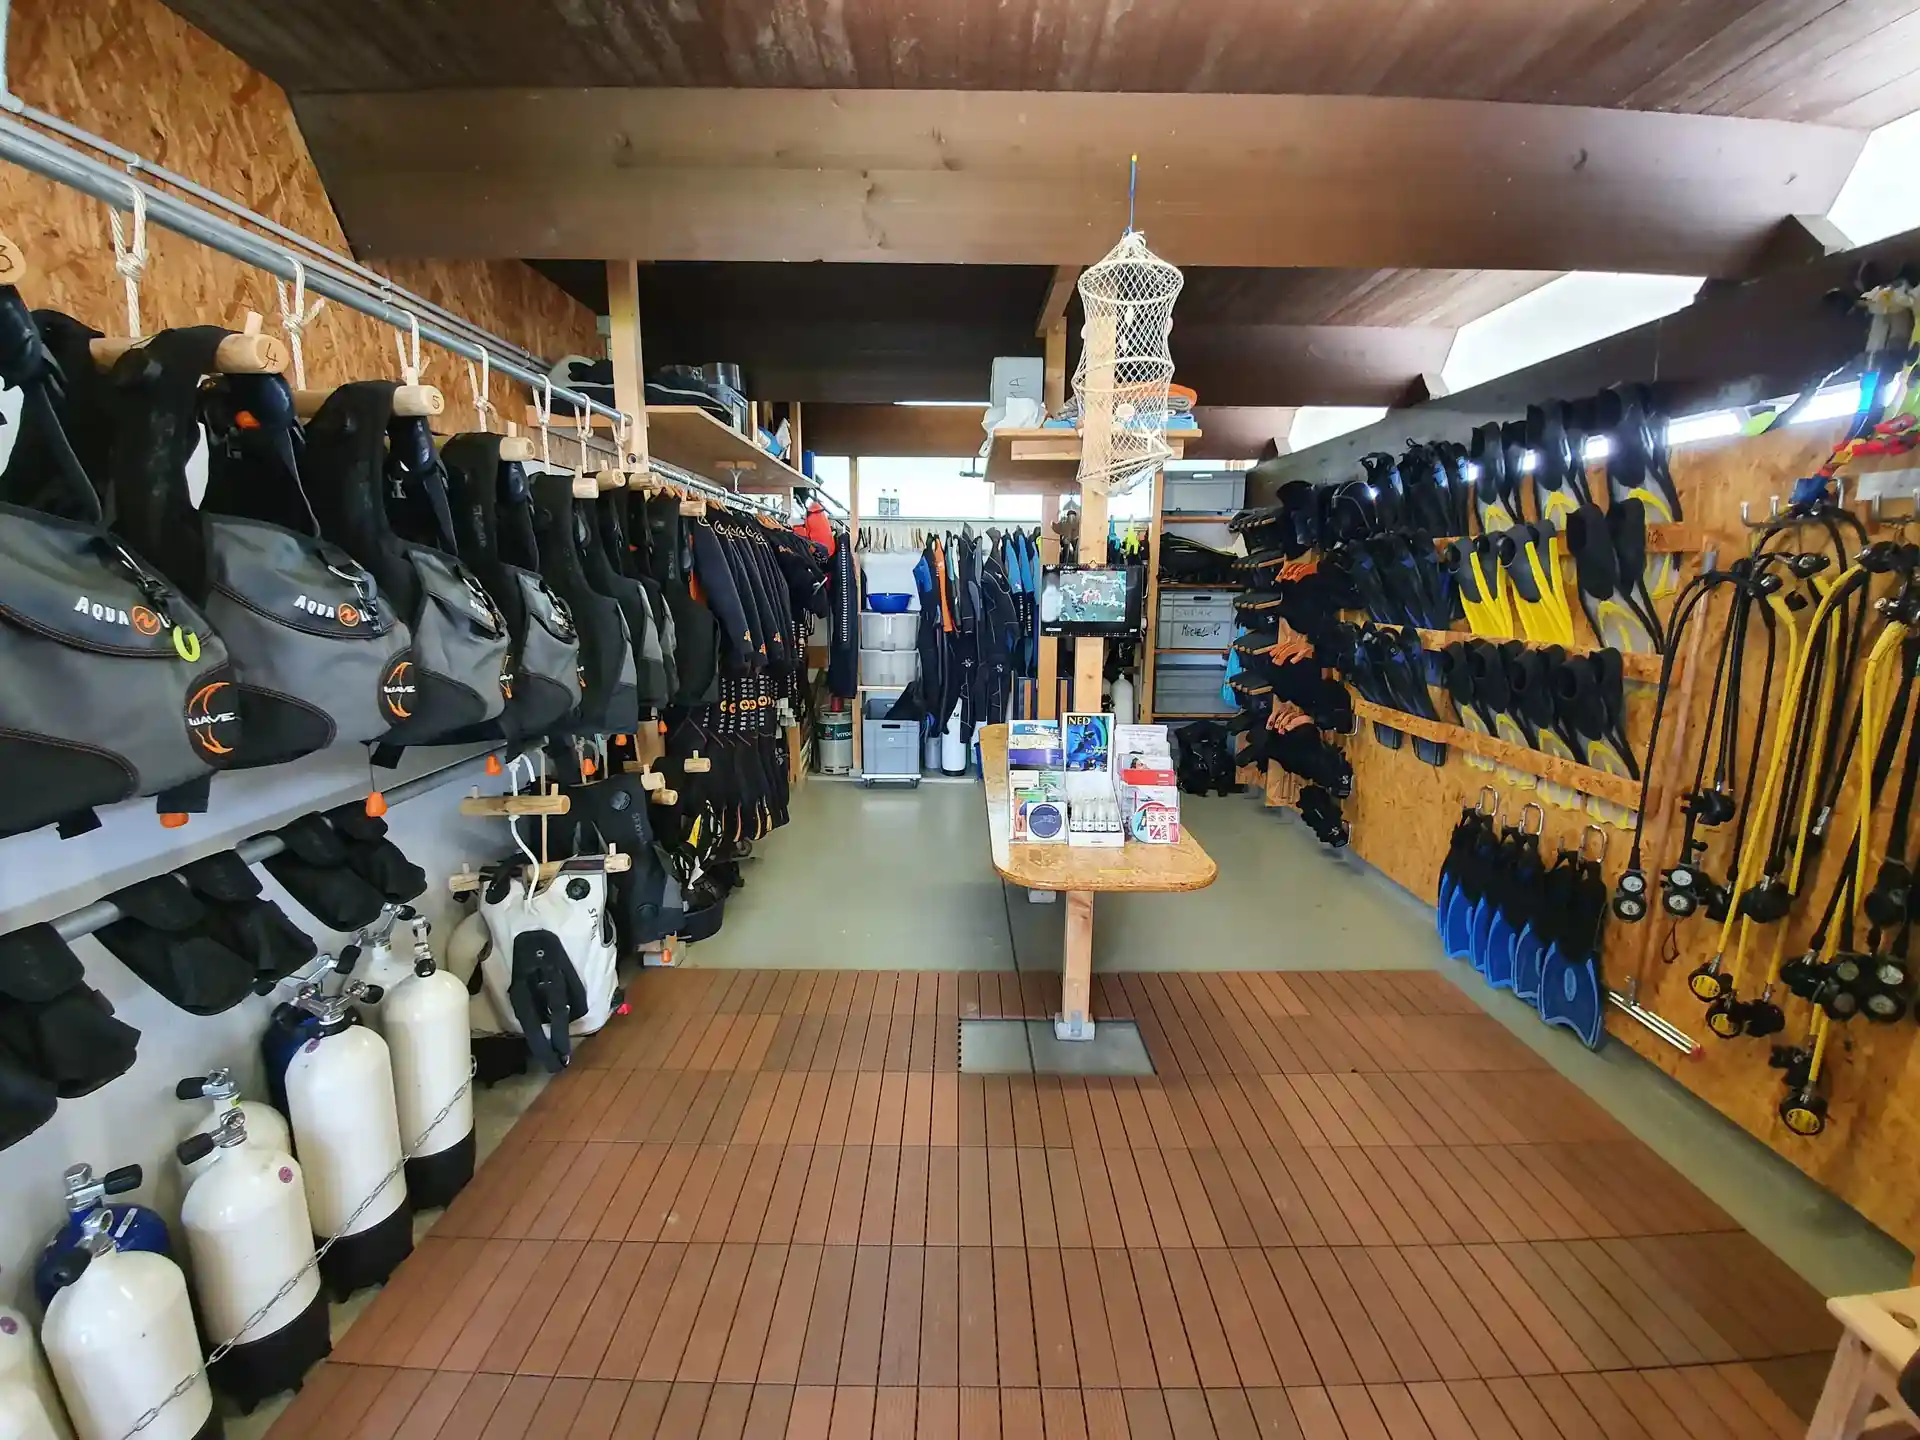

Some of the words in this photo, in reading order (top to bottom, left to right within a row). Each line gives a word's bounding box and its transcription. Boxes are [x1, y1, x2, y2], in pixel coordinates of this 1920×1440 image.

[73, 595, 131, 626] AQUA
[293, 594, 336, 619] AQUA
[383, 684, 417, 694] WAVE
[188, 711, 236, 727] WAVE
[1068, 716, 1091, 726] NED
